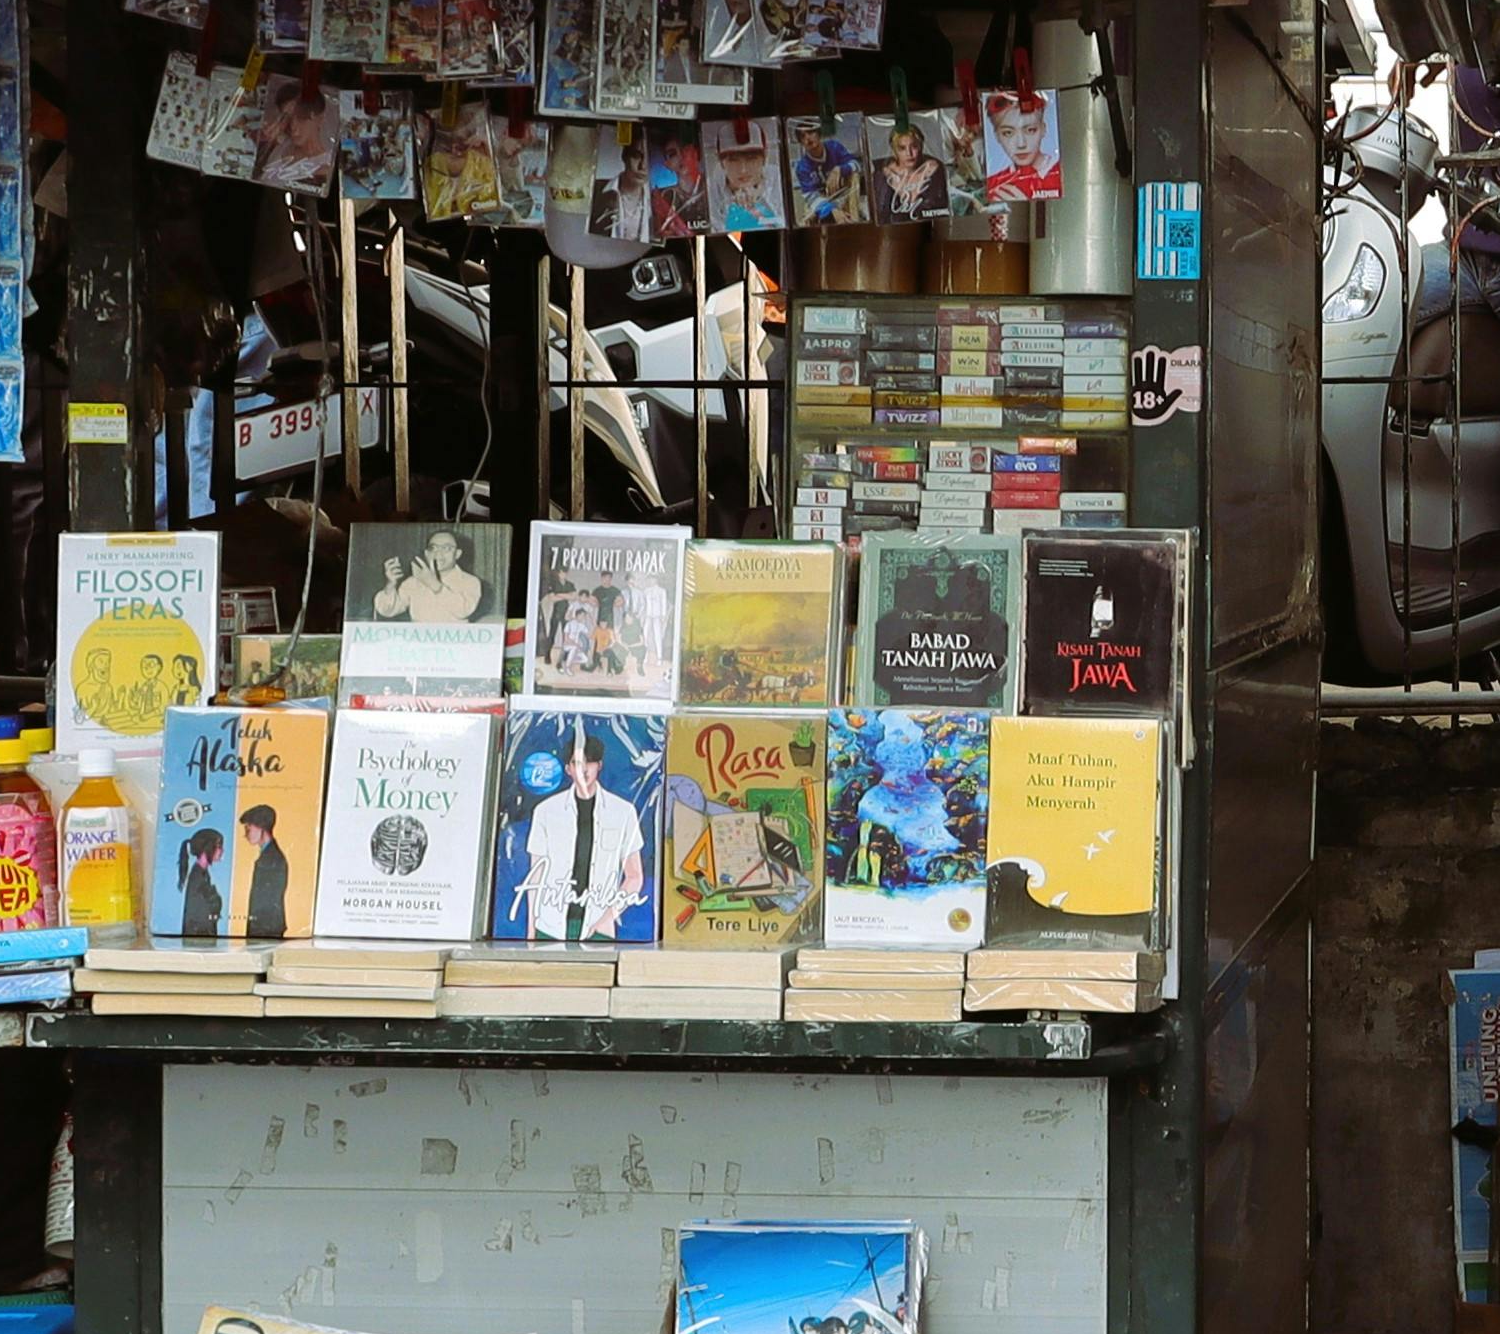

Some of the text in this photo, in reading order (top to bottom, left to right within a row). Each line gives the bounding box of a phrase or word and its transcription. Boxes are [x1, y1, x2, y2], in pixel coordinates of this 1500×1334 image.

[1133, 391, 1165, 410] 18+
[239, 423, 252, 448] B
[361, 389, 374, 415] X
[886, 411, 928, 424] TWIZZ
[936, 450, 963, 460] LUCKY
[936, 460, 964, 469] STRIKE
[86, 551, 117, 560] HENRY
[551, 546, 669, 572] 7 PRAJURIT BAPAK
[716, 556, 802, 572] PRAMOEDYA
[75, 569, 203, 593] FILOSOFI
[94, 597, 184, 620] TERAS
[351, 627, 494, 644] MOHAMMAD
[910, 633, 970, 651] BABAD
[1056, 641, 1141, 659] KISAH TANAH
[882, 649, 997, 671] TANAH JAWA
[1069, 658, 1136, 693] JAWA
[220, 717, 272, 745] Teluk
[186, 737, 284, 790] Alaska
[358, 747, 461, 779] Psychology
[696, 724, 785, 795] Rasa
[1028, 752, 1118, 770] Maaf Tuhan,
[1027, 775, 1117, 793] Aku Hampir
[354, 777, 458, 818] Money
[1026, 795, 1097, 812] Menyerah
[64, 830, 118, 845] ORANGE
[66, 847, 116, 862] WATER
[513, 858, 648, 923] Antariksa
[343, 898, 443, 911] MORGAN HOUSEL
[707, 917, 780, 934] Tere Liye
[1480, 1007, 1499, 1103] UNTUNG
